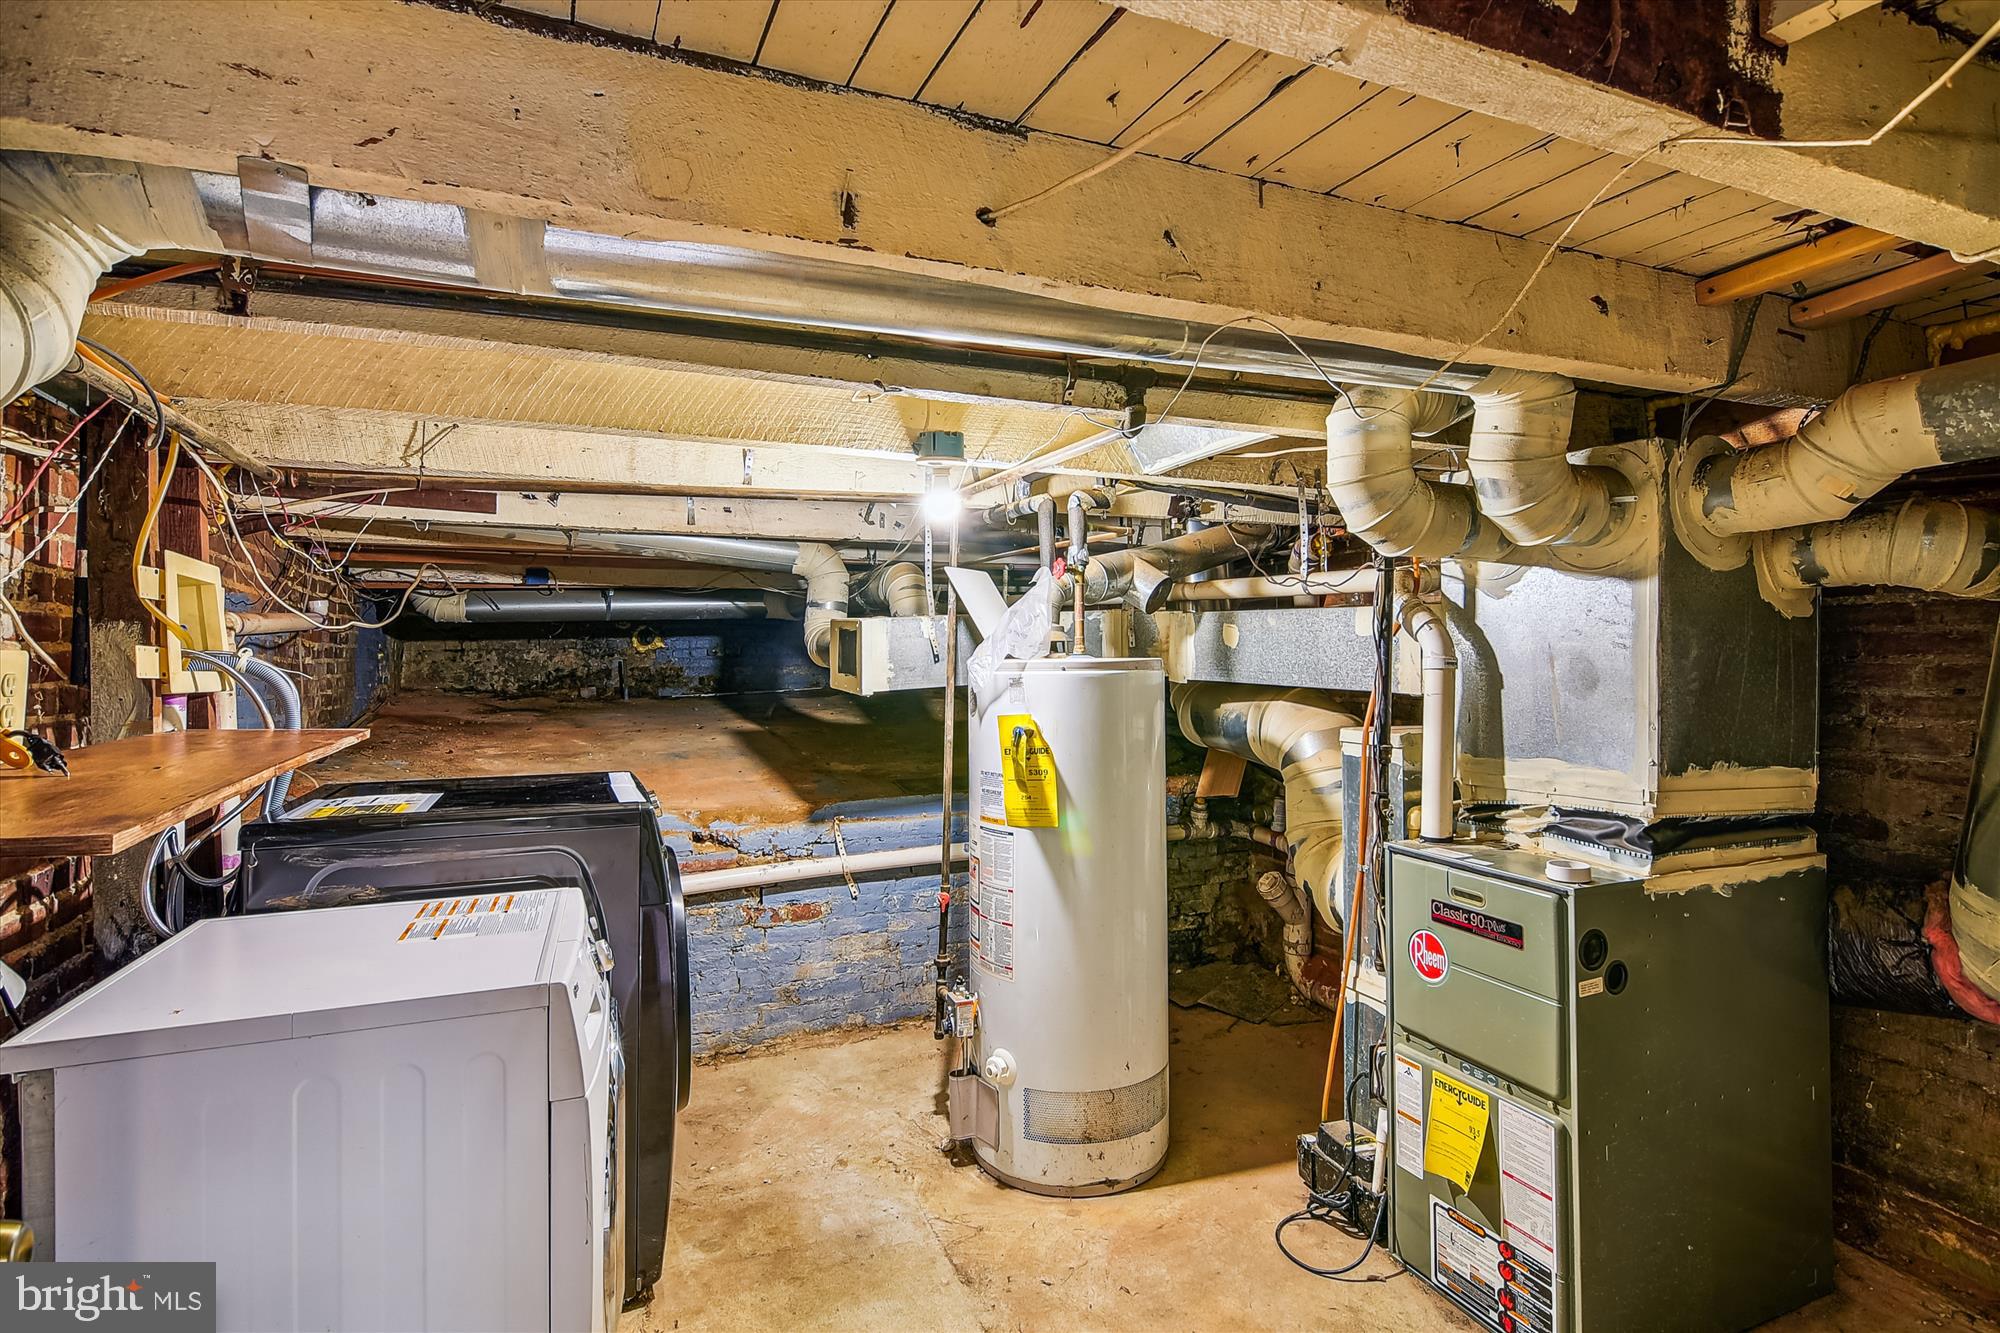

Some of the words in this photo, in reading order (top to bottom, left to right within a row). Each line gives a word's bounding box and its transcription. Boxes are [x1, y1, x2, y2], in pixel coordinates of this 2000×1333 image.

[1432, 901, 1469, 924] Classic
[1414, 932, 1445, 972] Rheem
[1434, 1078, 1486, 1111] ENERGYGUIDE
